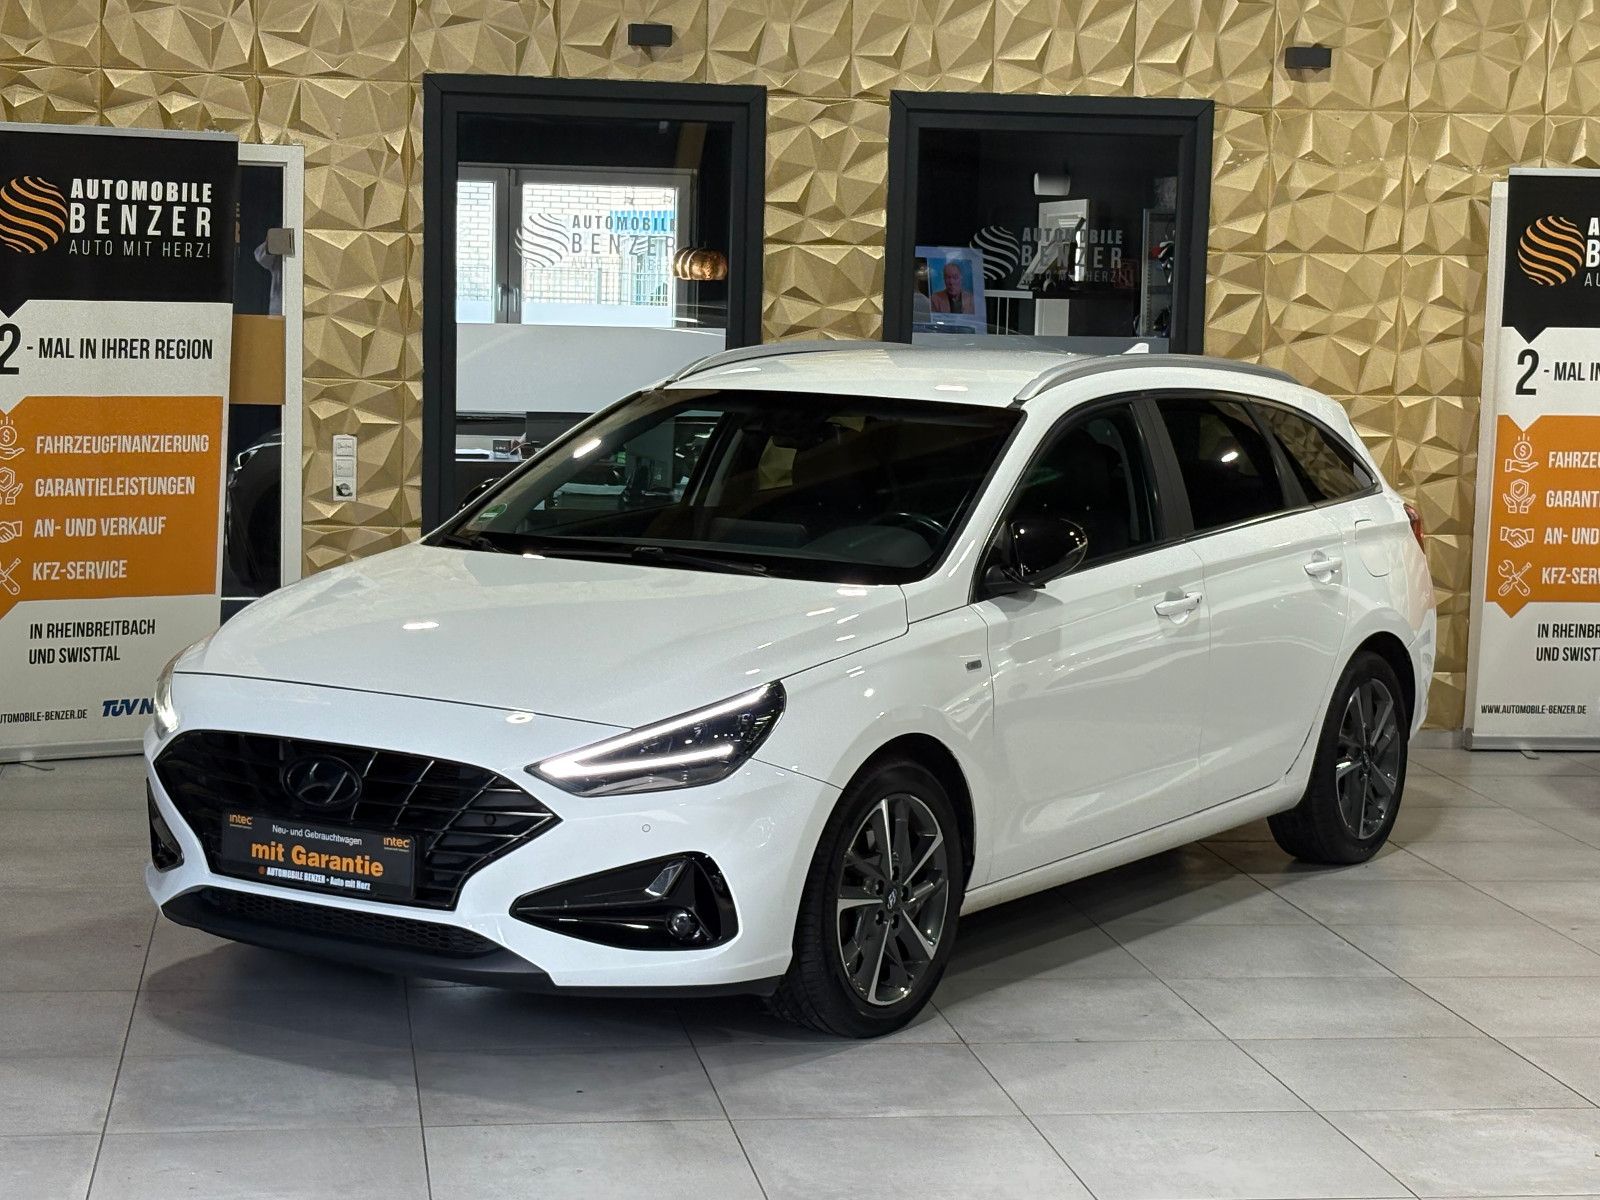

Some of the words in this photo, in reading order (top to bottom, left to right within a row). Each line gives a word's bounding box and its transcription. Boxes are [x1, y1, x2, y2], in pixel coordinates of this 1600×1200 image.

[70, 178, 212, 203] AUTOMOBILE
[69, 202, 211, 237] BENZER
[68, 239, 113, 256] AUTO
[123, 240, 152, 257] MIT
[162, 241, 211, 258] HERZ!
[571, 233, 676, 257] BENZER
[1021, 245, 1122, 269] BENZER
[0, 322, 21, 375] 2
[38, 337, 74, 359] MAL
[79, 337, 97, 359] IN
[101, 338, 150, 360] IHRER
[154, 338, 213, 360] REGION
[1515, 348, 1540, 396] 2
[1553, 361, 1586, 382] MAL
[36, 434, 209, 455] FAHRZEUGFINANZIERUNG
[35, 475, 195, 498] GARANTIELEISTUNGEN
[33, 518, 61, 538] AN-
[65, 518, 97, 537] UND
[100, 516, 167, 536] VERKAUF
[1543, 527, 1568, 545] AN-
[1571, 527, 1600, 545] UND
[32, 559, 128, 581] KFZ-SERVICE
[29, 623, 43, 640] IN
[46, 618, 156, 638] RHEINBREITBACH
[1537, 623, 1550, 639] IN
[29, 648, 56, 665] UND
[58, 645, 121, 663] SWISTTAL
[1536, 646, 1560, 662] UND
[1480, 704, 1587, 715] WWW.AUTOMOBILE-BENZER.DE
[229, 813, 254, 826] intec
[272, 824, 289, 835] Neu-
[290, 827, 304, 838] und
[304, 829, 363, 846] Gebrauchtwagen
[383, 836, 410, 849] intec
[251, 840, 284, 863] mit
[291, 843, 384, 877] Garantie
[266, 867, 304, 881] AUTOMOBILE
[304, 872, 326, 884] BENZER
